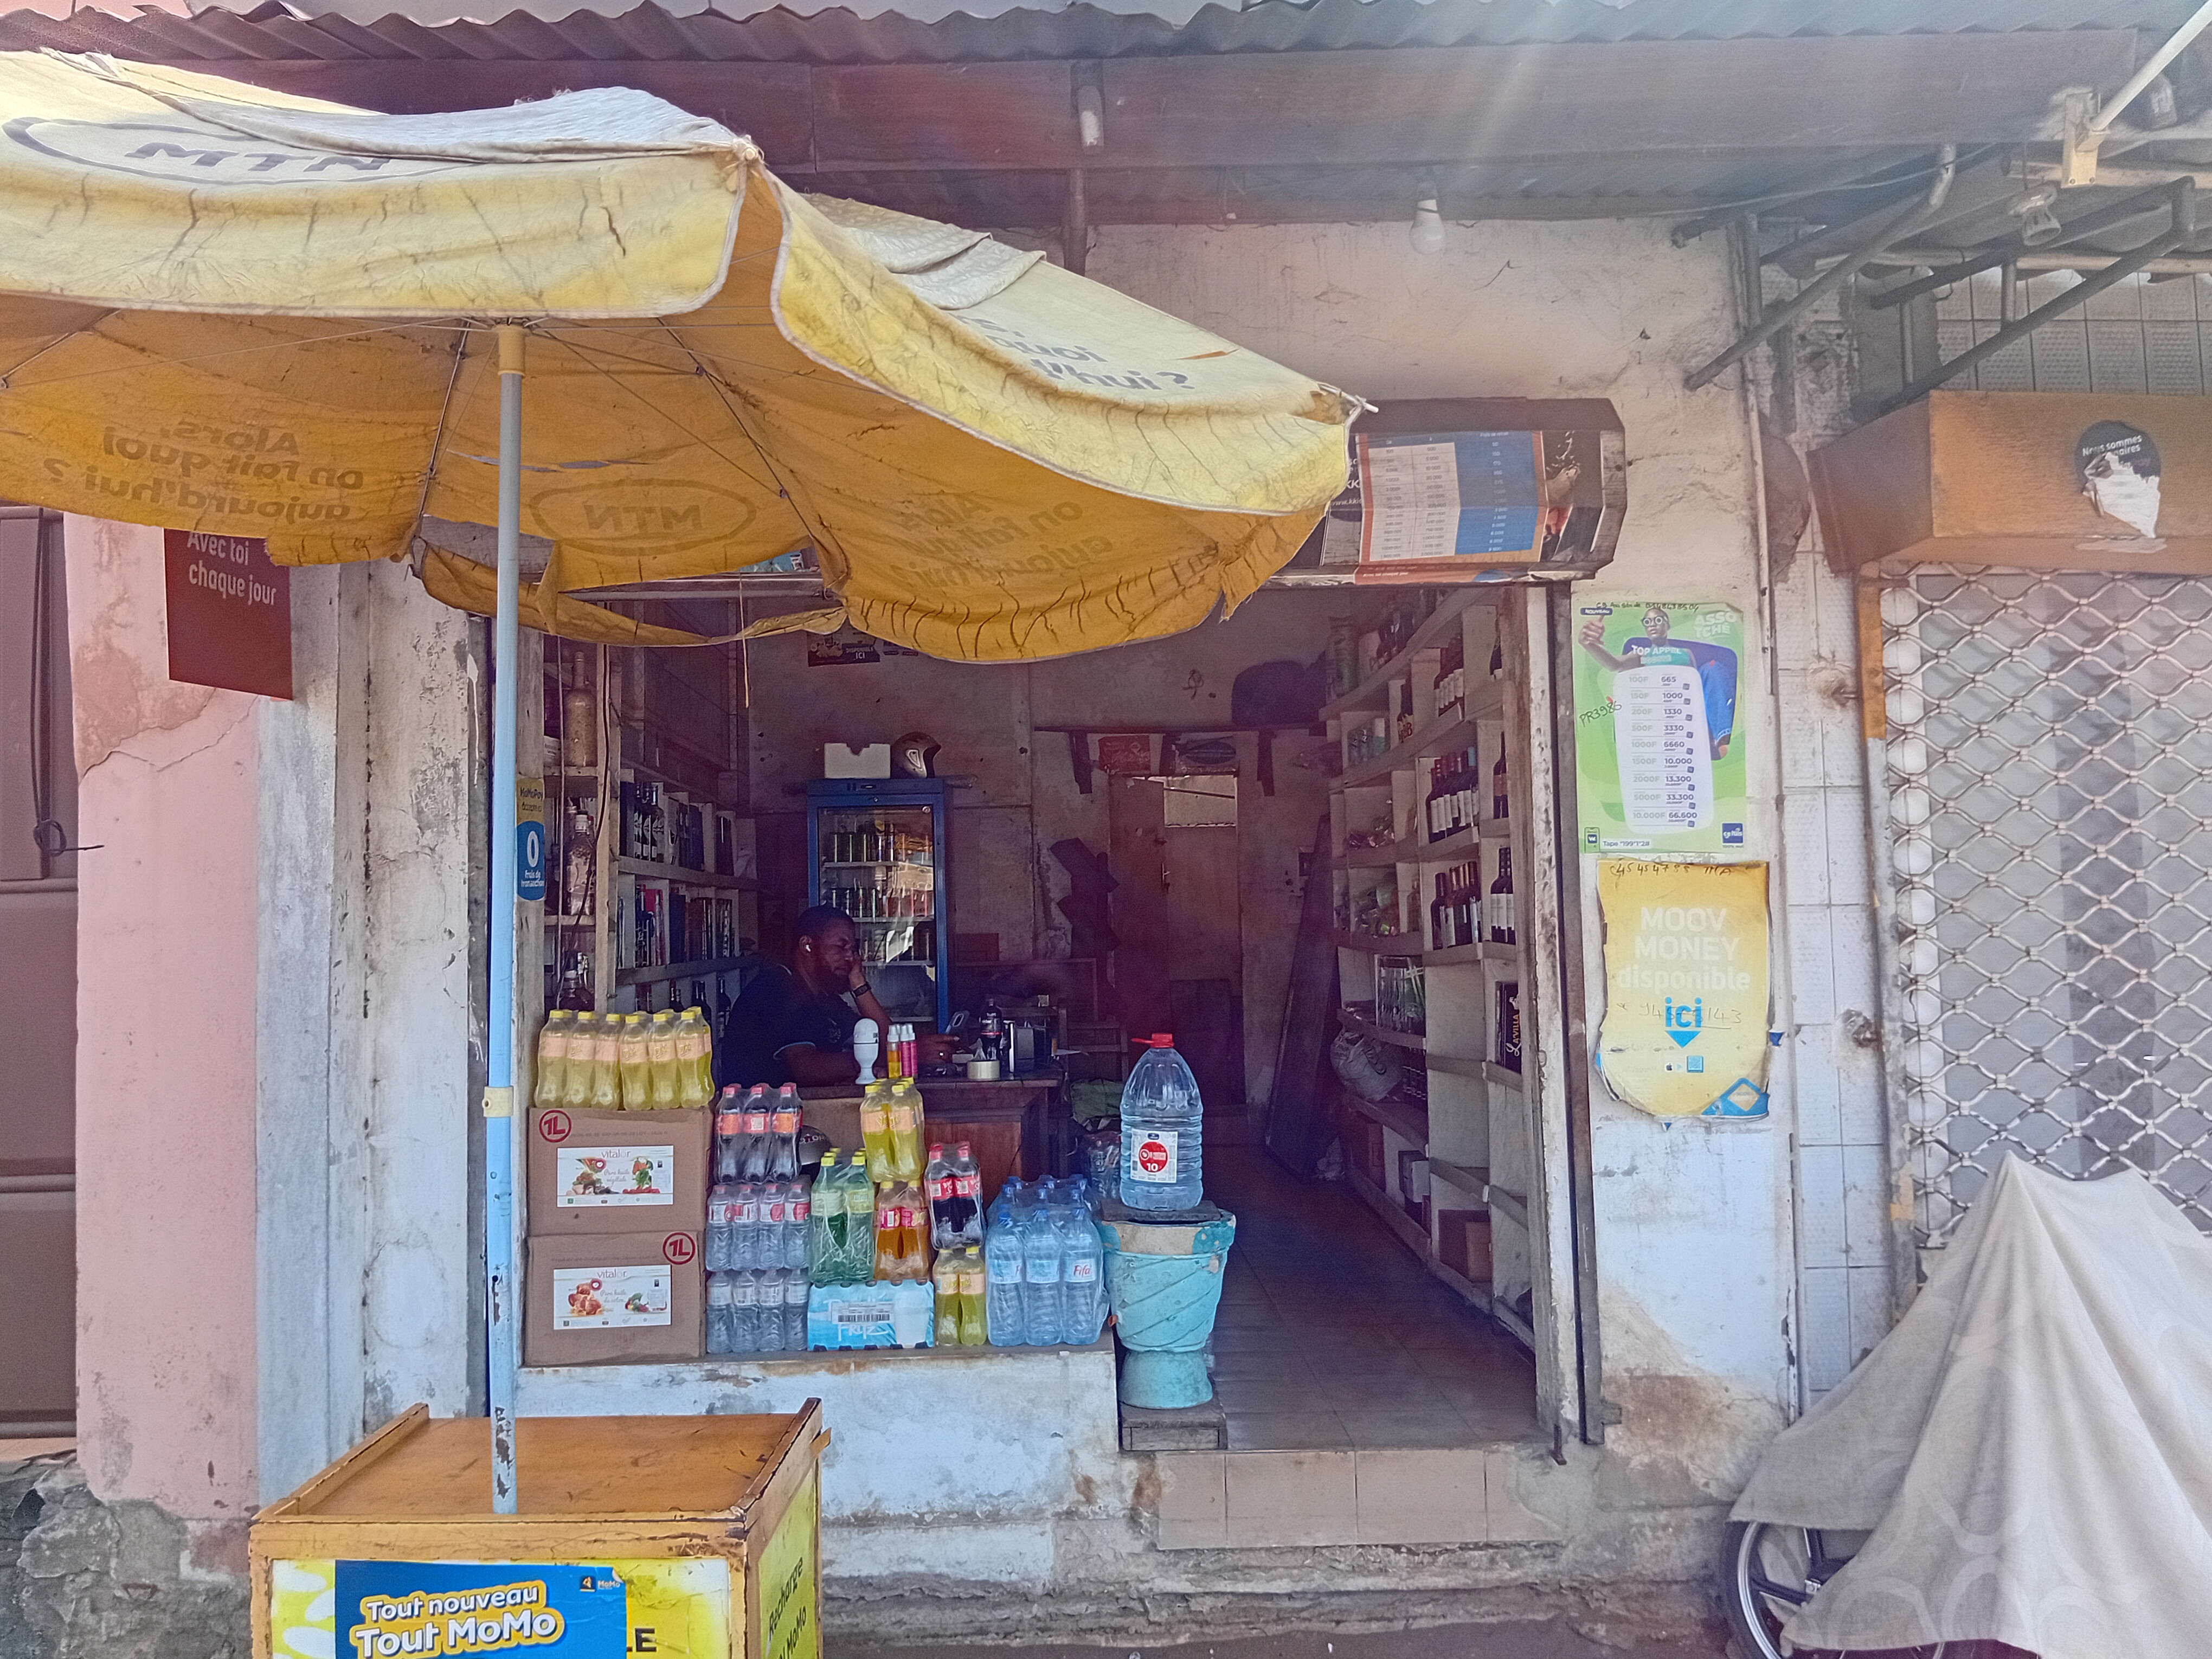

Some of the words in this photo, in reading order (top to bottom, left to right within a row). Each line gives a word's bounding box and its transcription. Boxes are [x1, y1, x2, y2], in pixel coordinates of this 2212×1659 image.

[125, 142, 391, 172] MTN
[2106, 435, 2143, 450] sommes
[187, 531, 227, 558] Avec
[230, 538, 249, 565] toi
[189, 560, 246, 599] chaque
[248, 574, 276, 606] jour
[1631, 645, 1650, 655] TOP
[1652, 646, 1682, 654] APPEL
[527, 831, 539, 868] 0
[1641, 906, 1727, 931] MOOV
[1635, 935, 1740, 961] MONEY
[1617, 964, 1751, 994] disponible
[1665, 996, 1702, 1028] ici
[543, 1116, 566, 1136] 1L
[601, 1148, 631, 1158] vitalor
[1146, 1163, 1158, 1171] 10
[669, 1238, 690, 1257] 1L
[597, 1269, 627, 1278] vitalor
[1074, 1264, 1090, 1278] Fifa
[597, 1580, 621, 1589] MoMo
[366, 1597, 424, 1621] Tout
[428, 1586, 538, 1615] nouveau
[769, 1557, 803, 1642] Recharge
[356, 1622, 440, 1658] Tout
[448, 1609, 557, 1648] MoMo
